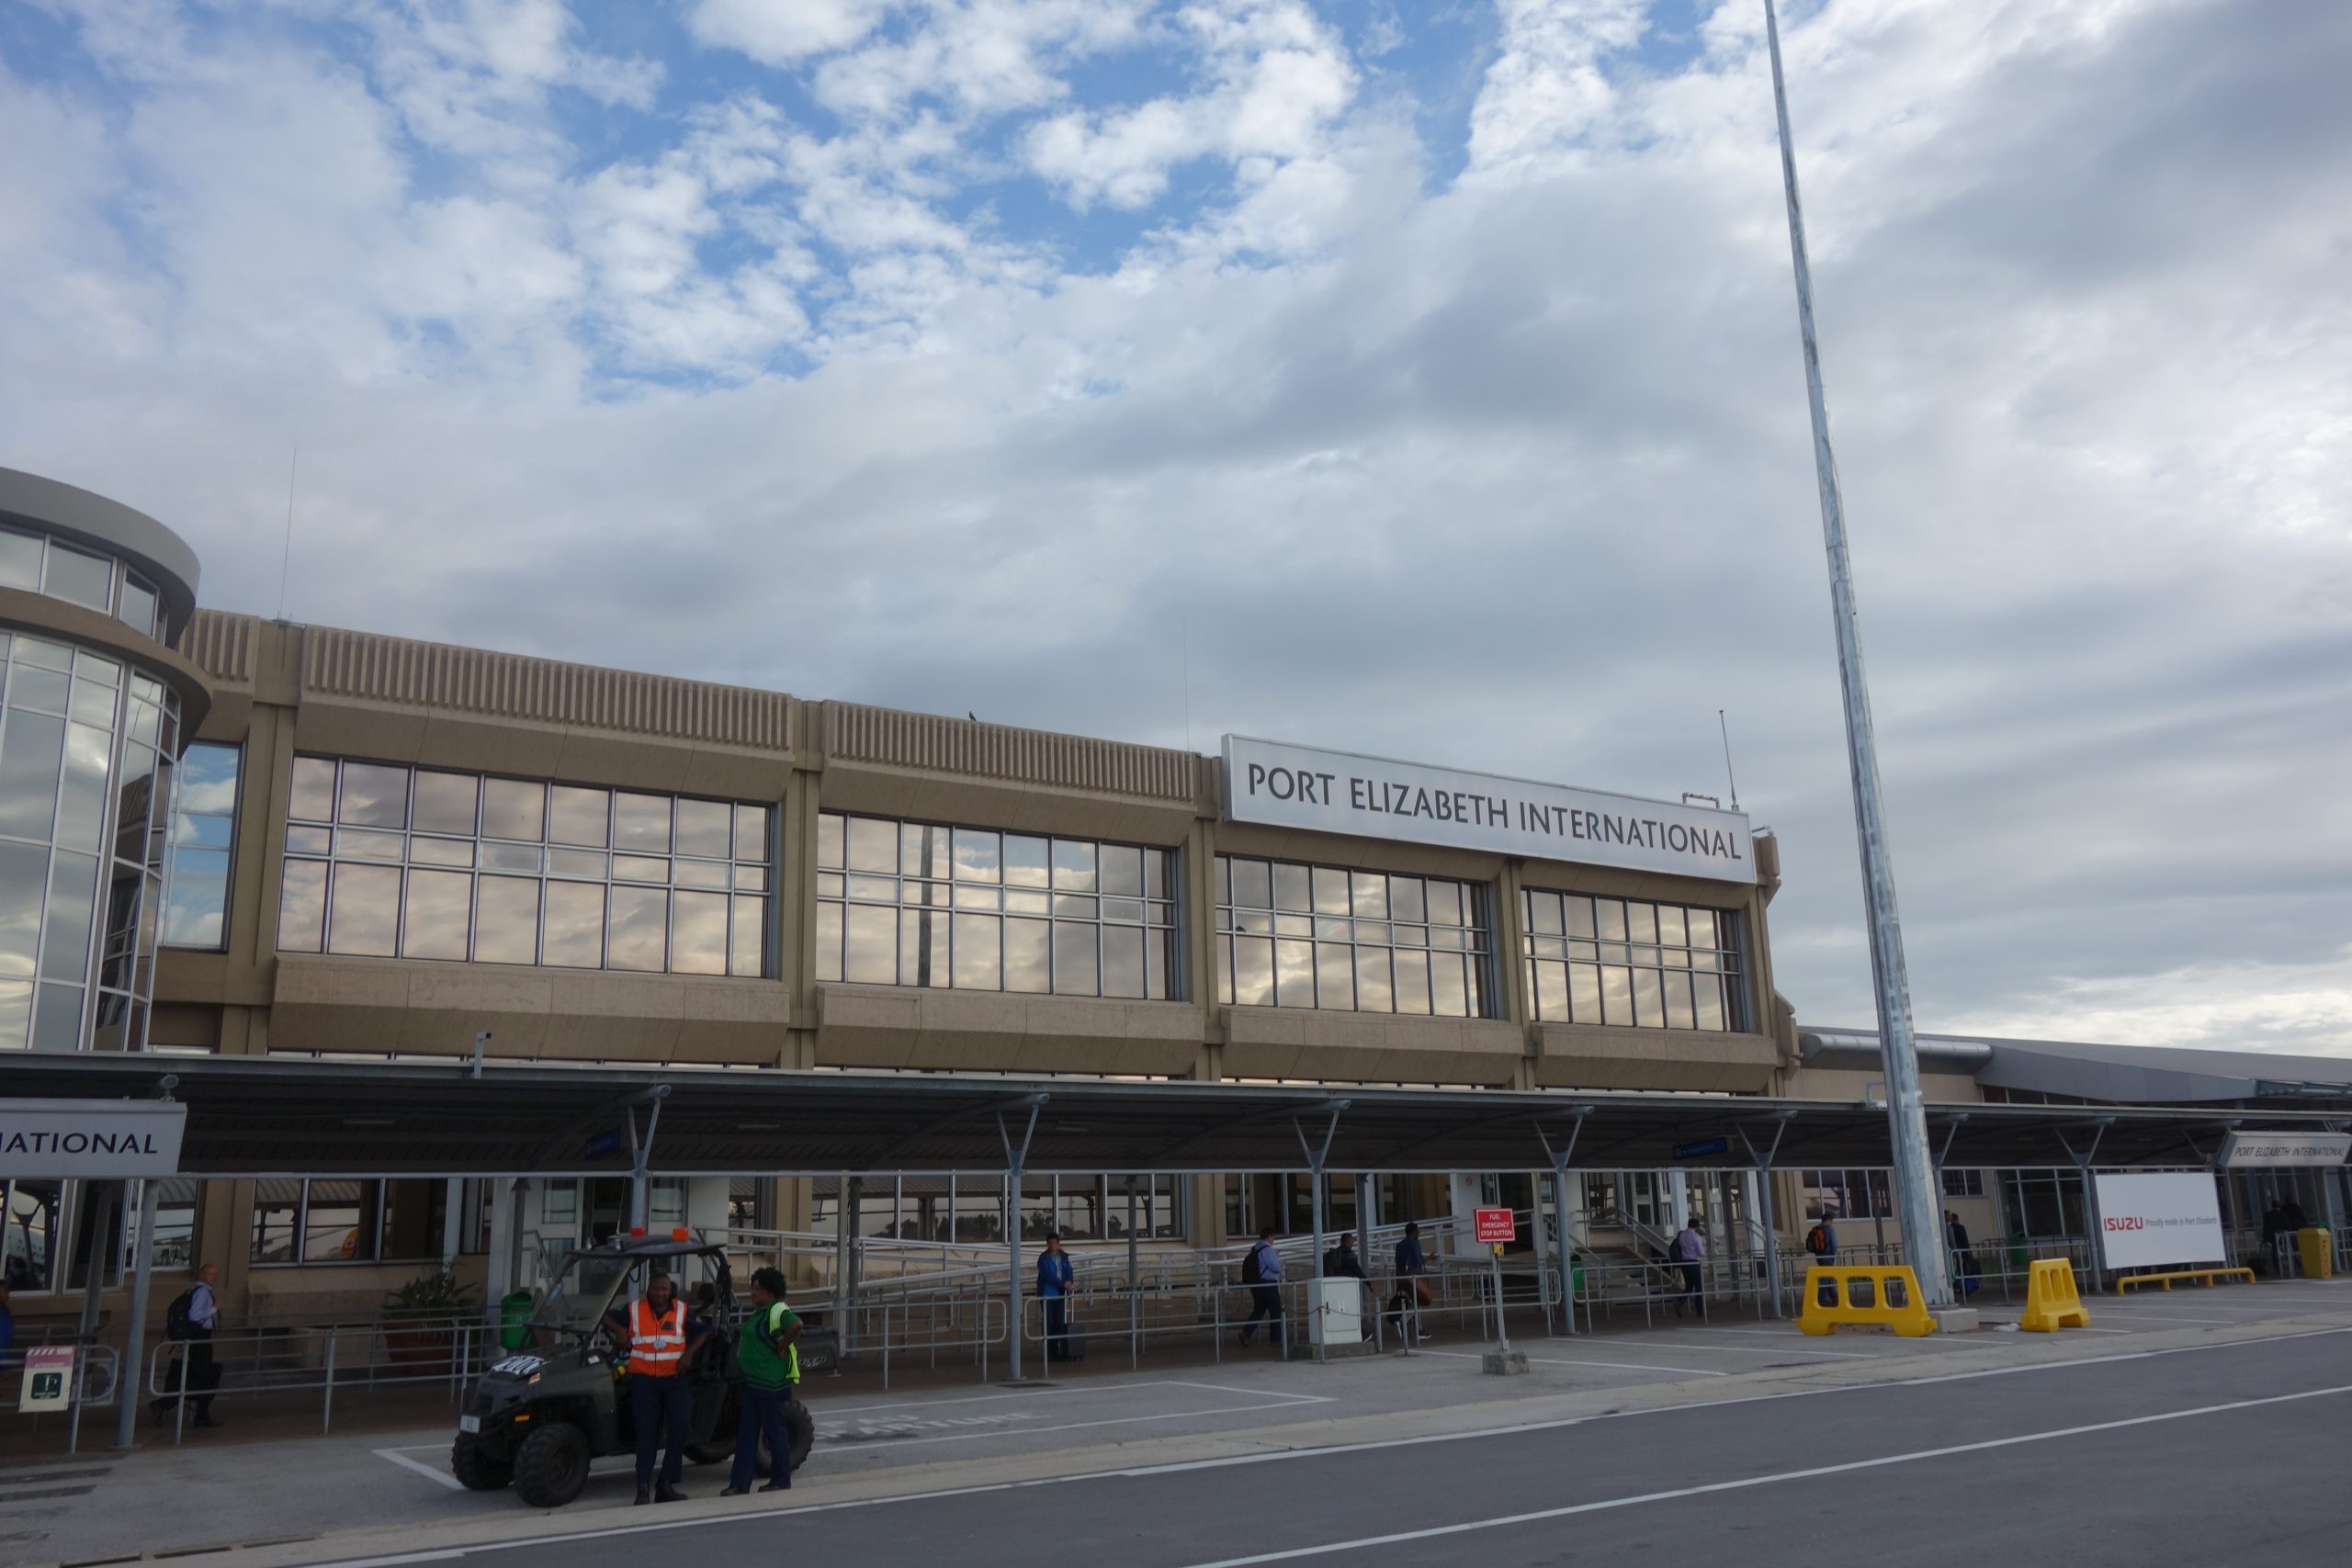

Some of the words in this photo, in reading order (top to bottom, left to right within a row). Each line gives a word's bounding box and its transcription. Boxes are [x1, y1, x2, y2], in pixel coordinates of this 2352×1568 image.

[1248, 763, 1336, 806] PORT
[1351, 777, 1509, 829] ELIZABETH
[1520, 801, 1743, 860] INTERNATIONAL
[2235, 1146, 2255, 1156] PORT
[2256, 1146, 2290, 1156] ELIZABETH
[2292, 1146, 2346, 1156] INTERNATIONAL
[2104, 1216, 2143, 1232] ISUZU
[2145, 1218, 2164, 1228] Proudly
[2185, 1217, 2195, 1225] Port
[2196, 1216, 2217, 1225] Elizabeth
